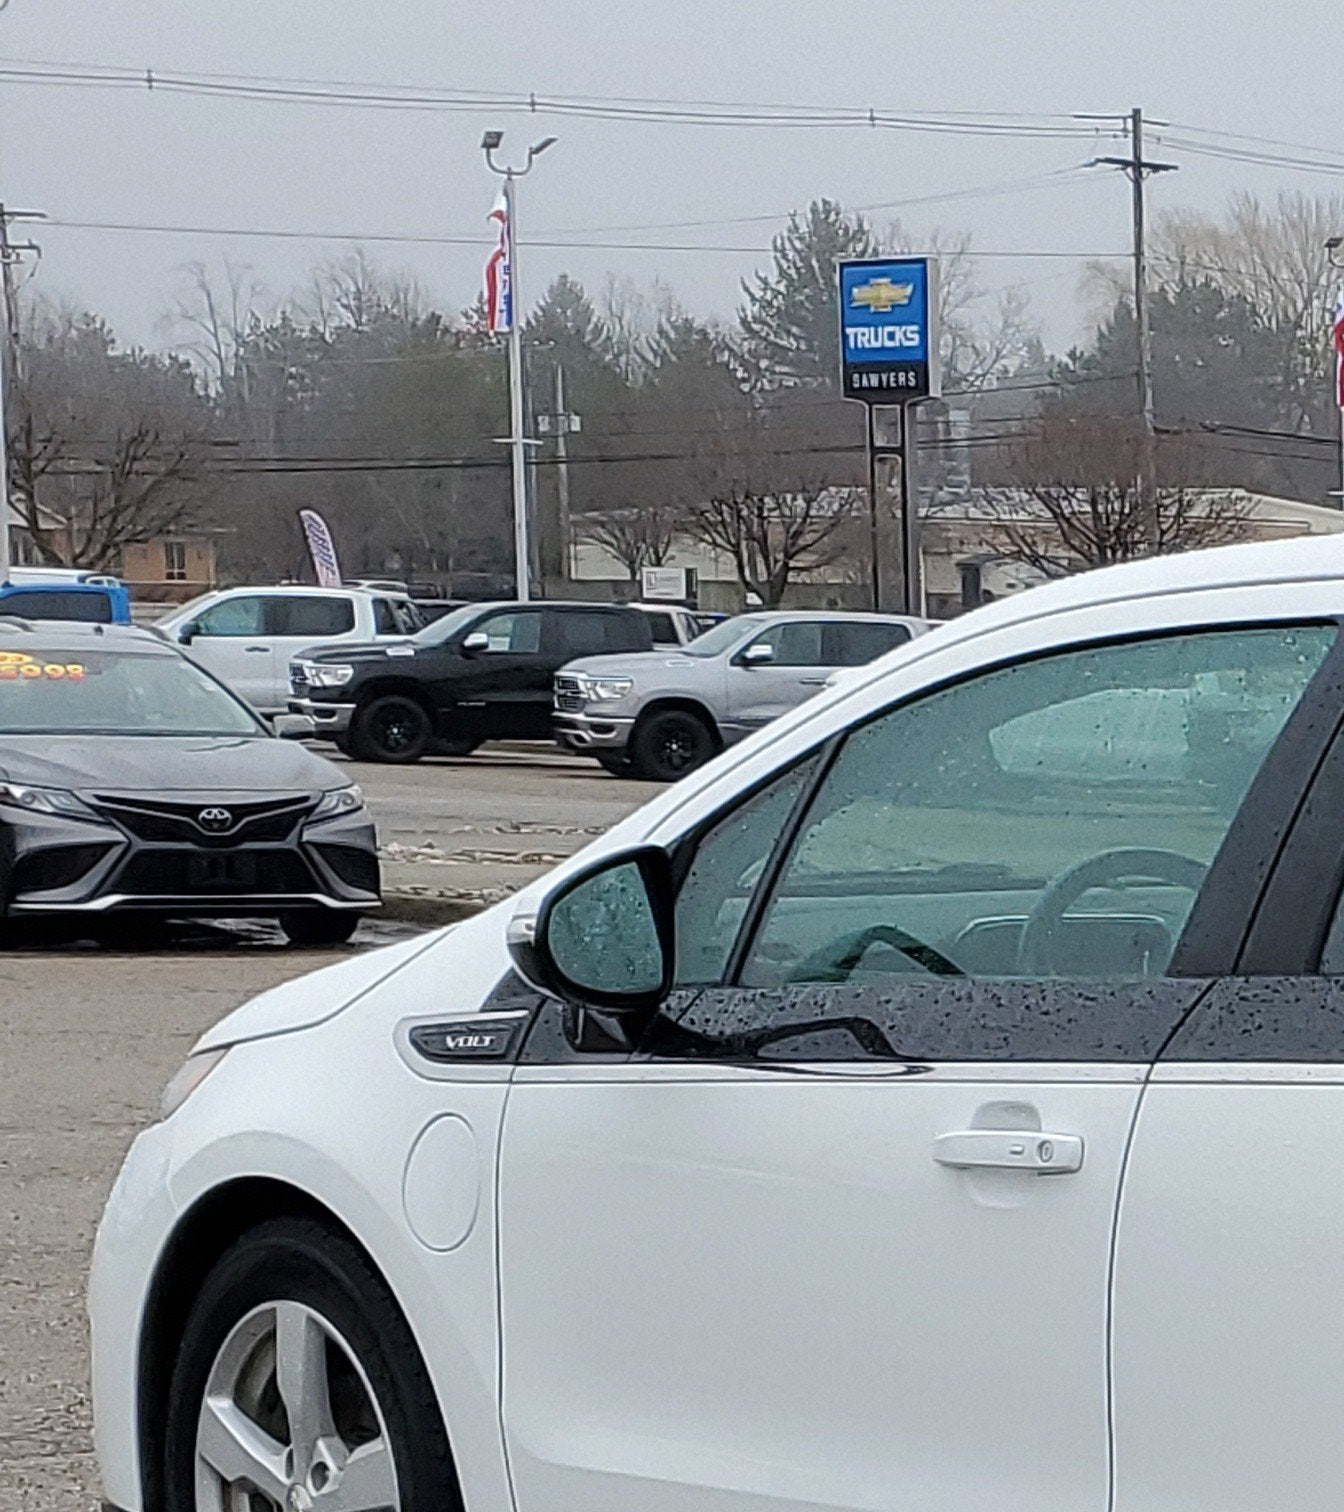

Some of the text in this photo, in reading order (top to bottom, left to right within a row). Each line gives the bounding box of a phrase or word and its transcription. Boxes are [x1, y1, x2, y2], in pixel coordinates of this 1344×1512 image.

[845, 325, 920, 349] TRUCKS
[851, 371, 916, 389] SAWYERS
[445, 1035, 496, 1049] VOLT
